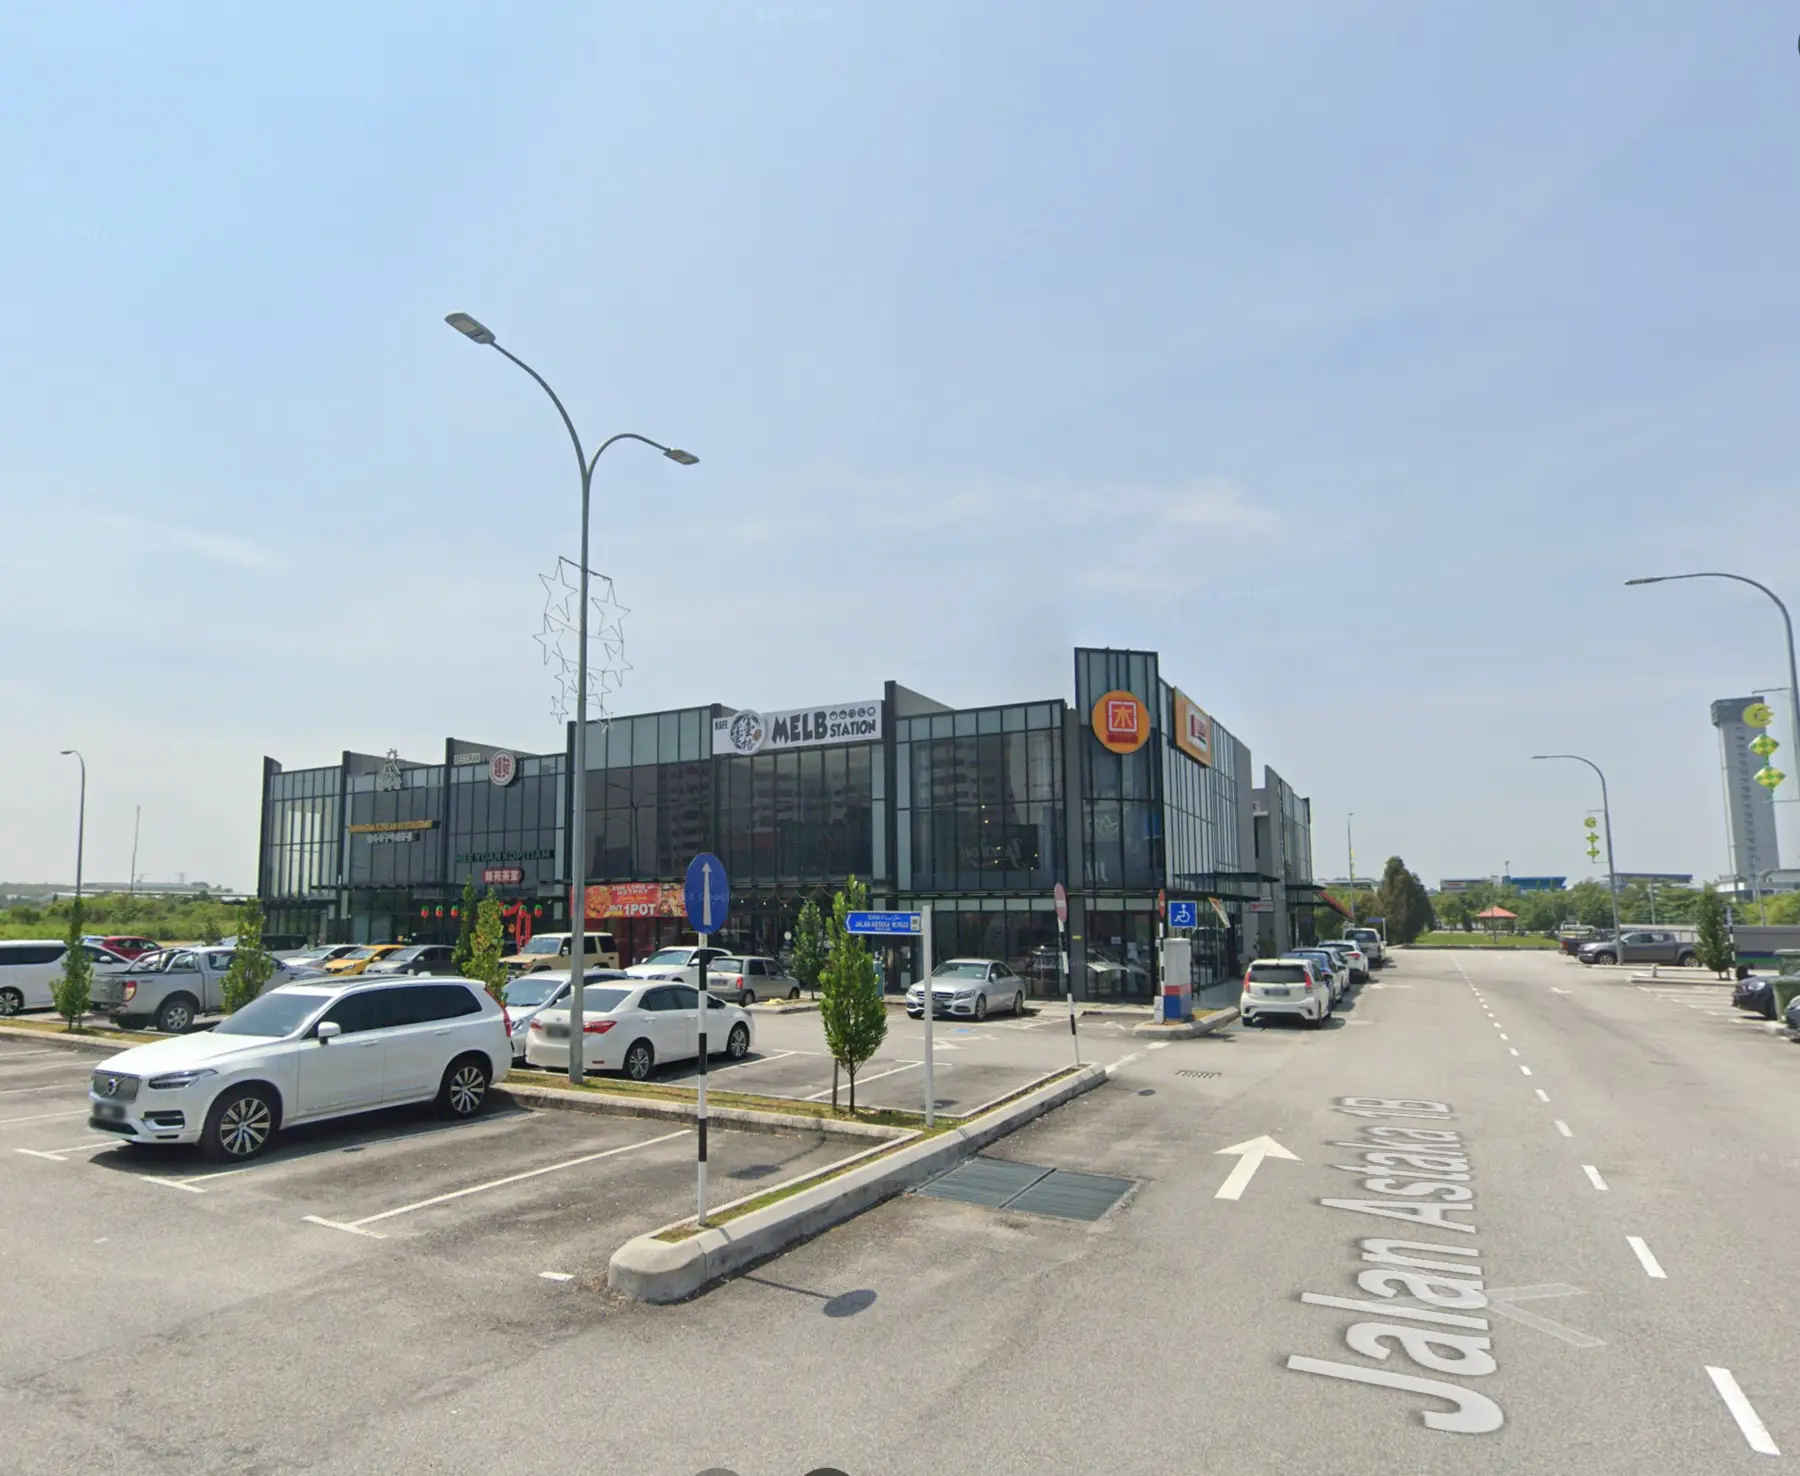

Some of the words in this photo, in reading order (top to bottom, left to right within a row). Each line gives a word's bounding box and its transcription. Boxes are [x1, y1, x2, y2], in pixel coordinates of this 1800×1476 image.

[714, 719, 729, 731] KAFE
[771, 711, 828, 744] MELB
[829, 719, 876, 738] STATION
[617, 888, 648, 896] HOTPOT
[855, 920, 872, 928] JALAN
[872, 920, 890, 928] ASTAKA
